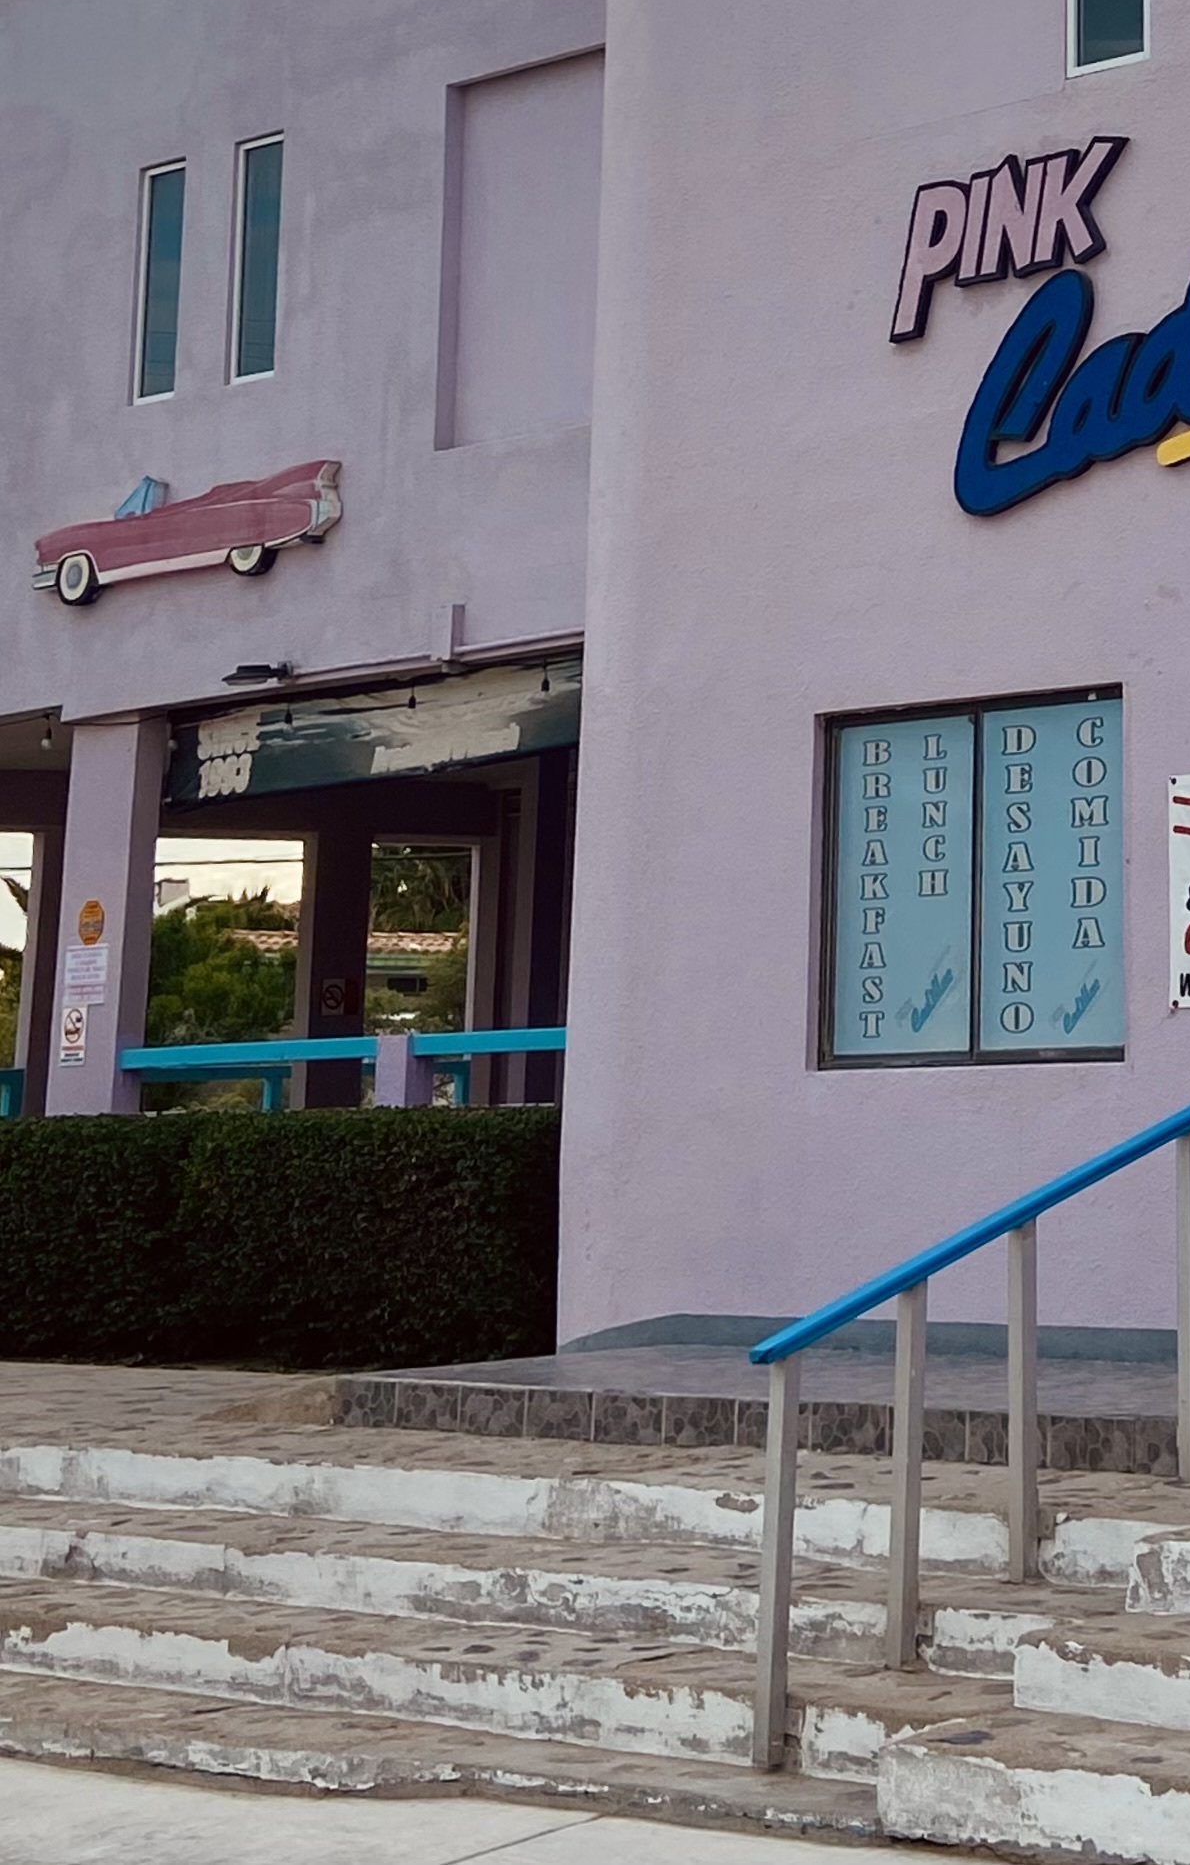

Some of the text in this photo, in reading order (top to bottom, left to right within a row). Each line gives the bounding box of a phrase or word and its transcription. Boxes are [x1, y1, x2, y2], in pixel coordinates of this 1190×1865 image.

[890, 136, 1129, 344] PINK
[859, 739, 891, 1038] BREAKFAST
[918, 734, 949, 897] LUNCH
[1000, 724, 1037, 1034] DESAYUNO
[1071, 717, 1109, 949] COMIDA
